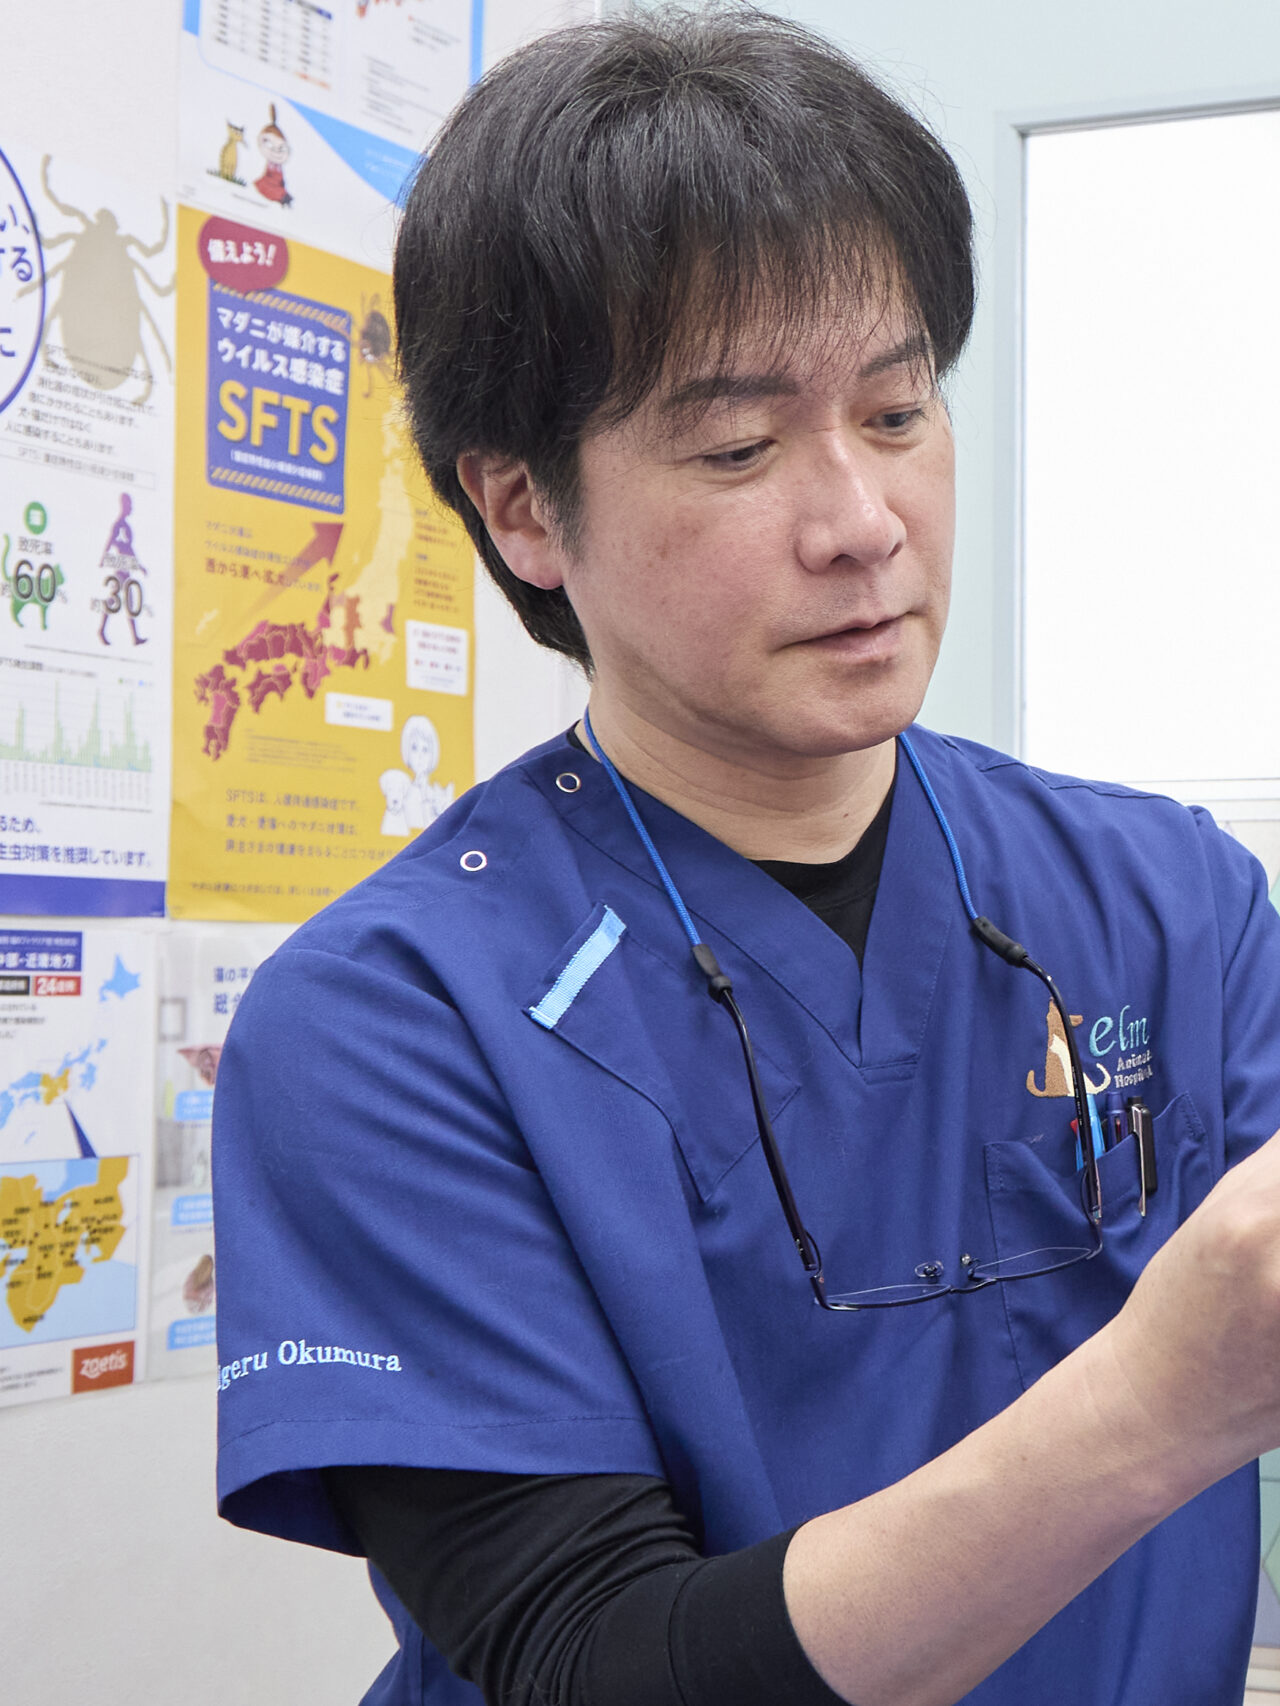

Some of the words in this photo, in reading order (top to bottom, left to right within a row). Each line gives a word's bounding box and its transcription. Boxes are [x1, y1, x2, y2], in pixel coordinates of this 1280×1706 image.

[0, 246, 33, 282] る
[216, 306, 347, 363] マダニが媒介する
[217, 337, 346, 396] ウイルス感染症
[216, 379, 340, 465] SFTS
[1089, 1004, 1150, 1058] elm
[1113, 1064, 1154, 1089] Hospital
[1116, 1049, 1153, 1072] Animal
[80, 1349, 128, 1379] zoetis
[277, 1339, 403, 1372] Okumura
